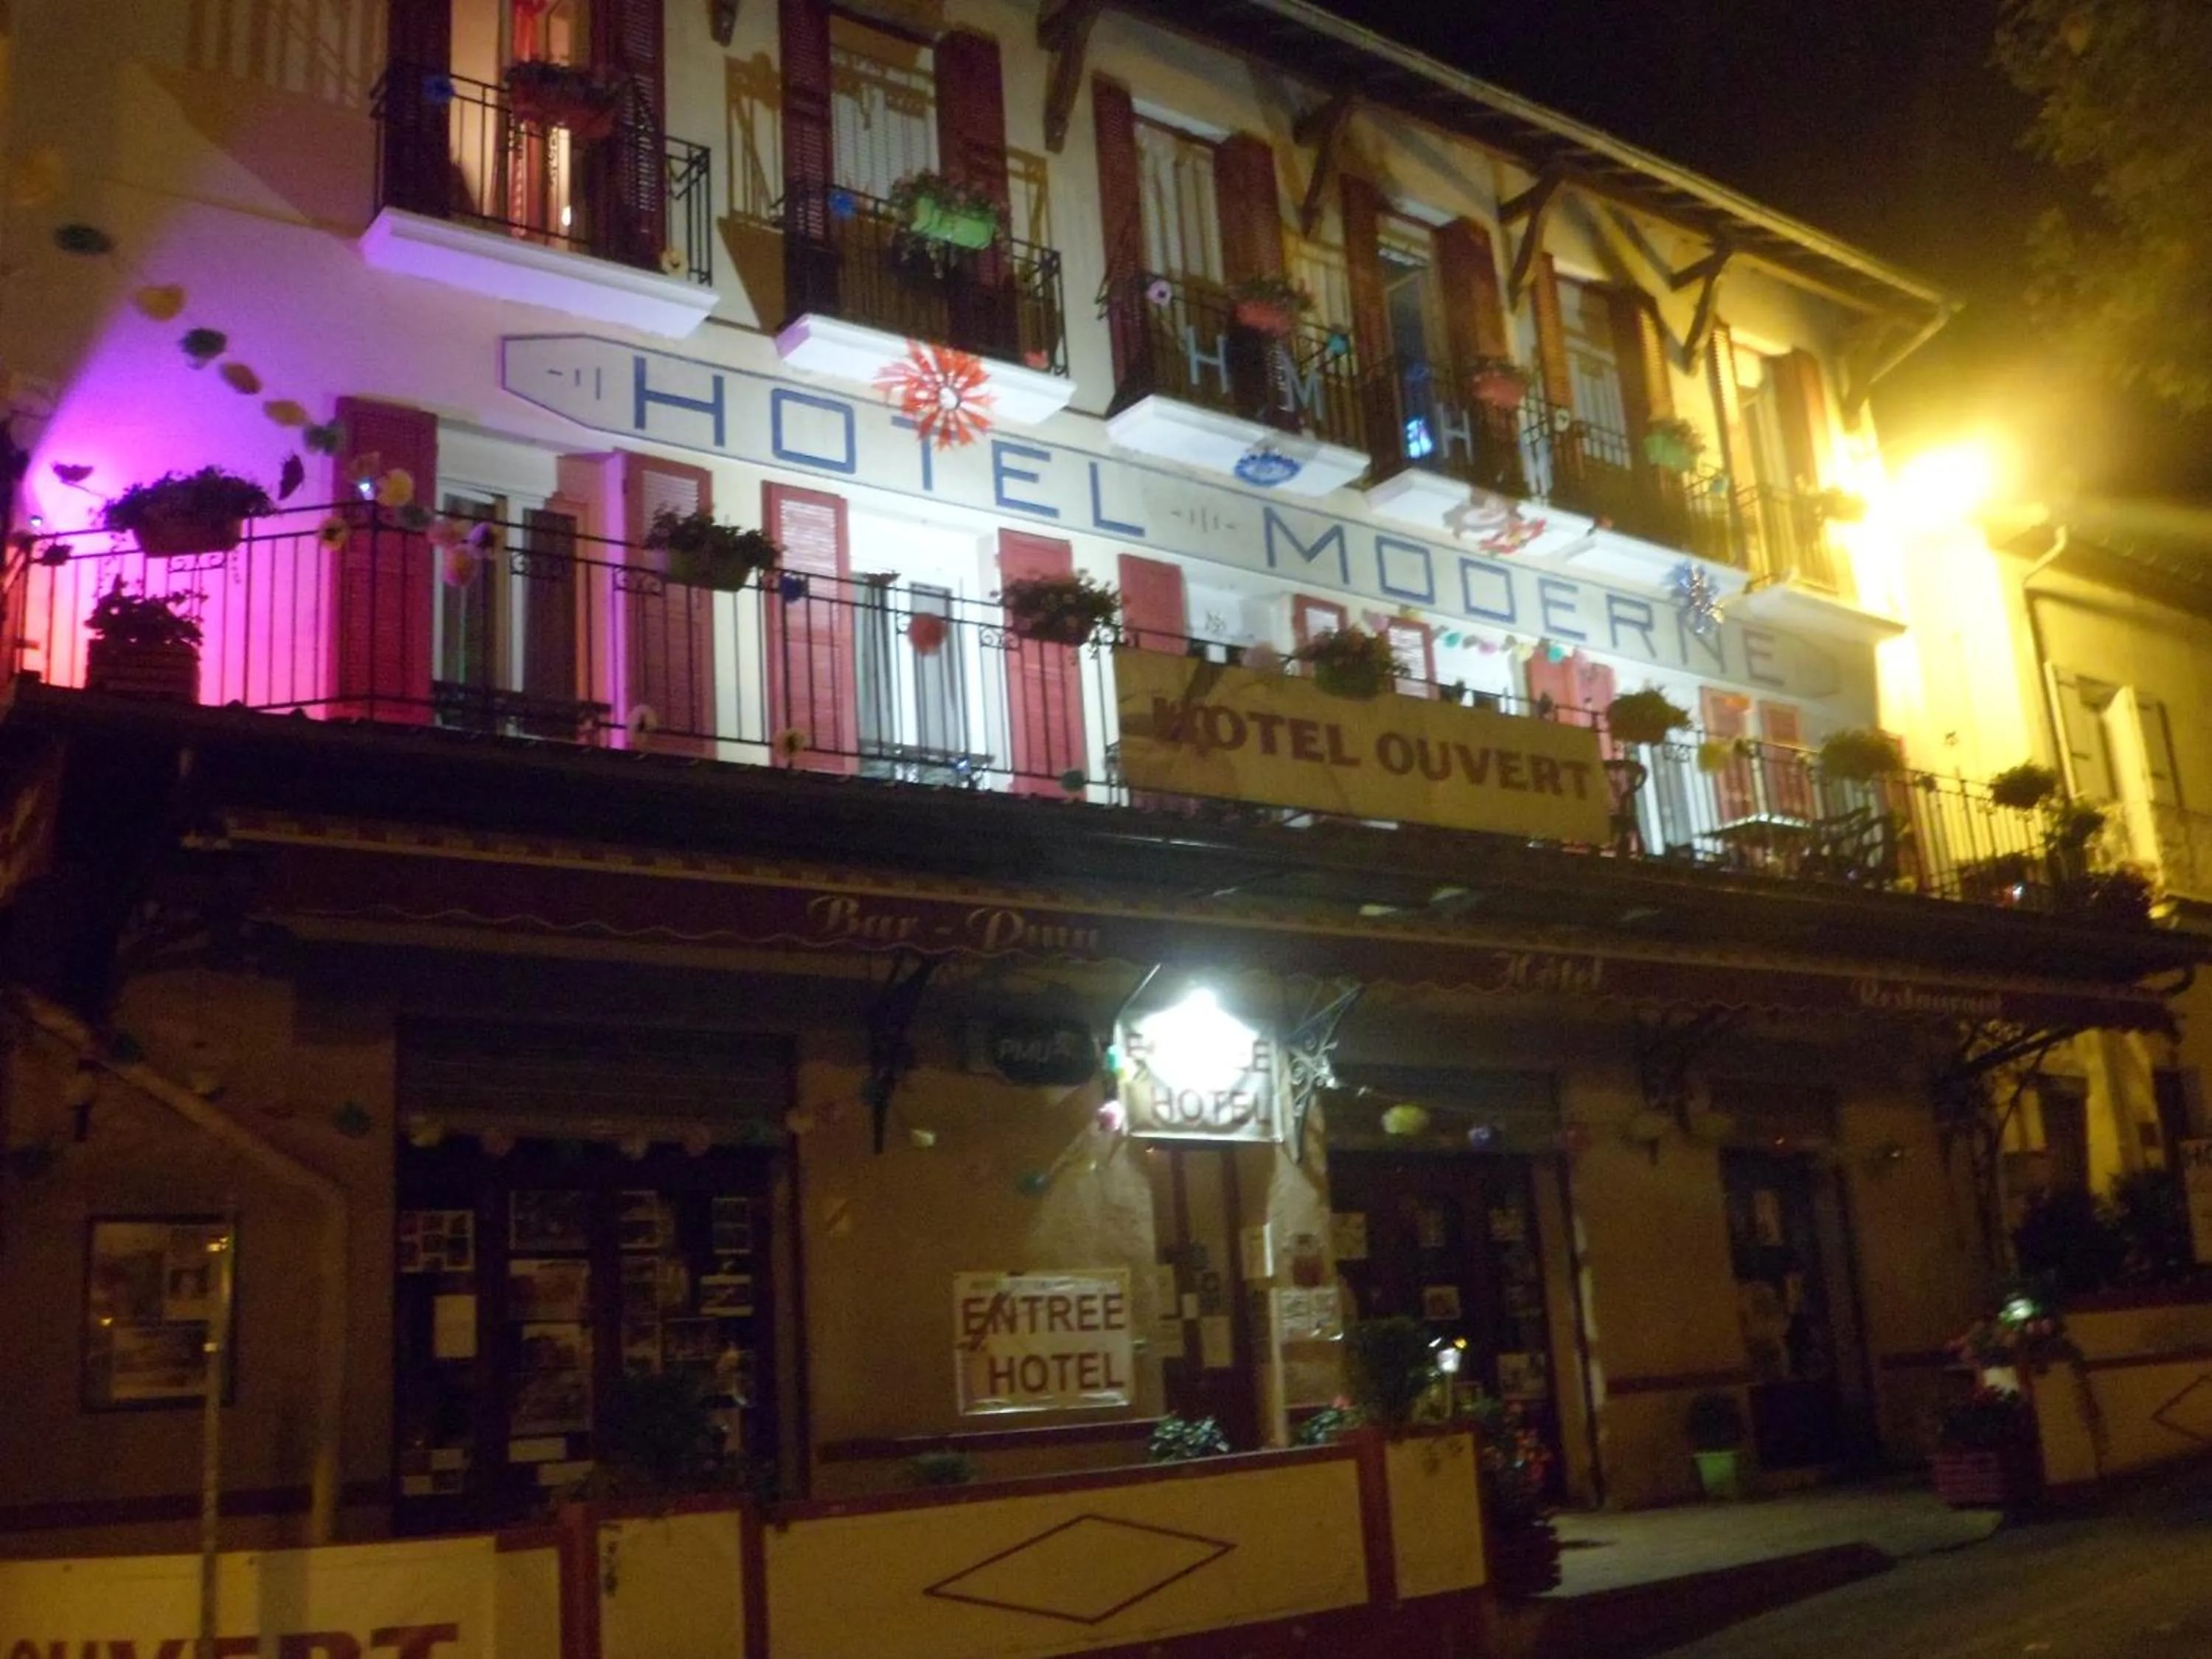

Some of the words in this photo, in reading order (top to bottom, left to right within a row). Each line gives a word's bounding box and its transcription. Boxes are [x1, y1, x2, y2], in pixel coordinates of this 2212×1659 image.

[632, 355, 1146, 538] HOTEL
[1262, 505, 1787, 687] MODERNE
[1152, 696, 1362, 767] HOTEL
[1376, 730, 1591, 801] OUVERT
[1152, 1087, 1271, 1125] HOTEL
[961, 1291, 1126, 1335] ENTREE
[987, 1351, 1125, 1396] HOTEL
